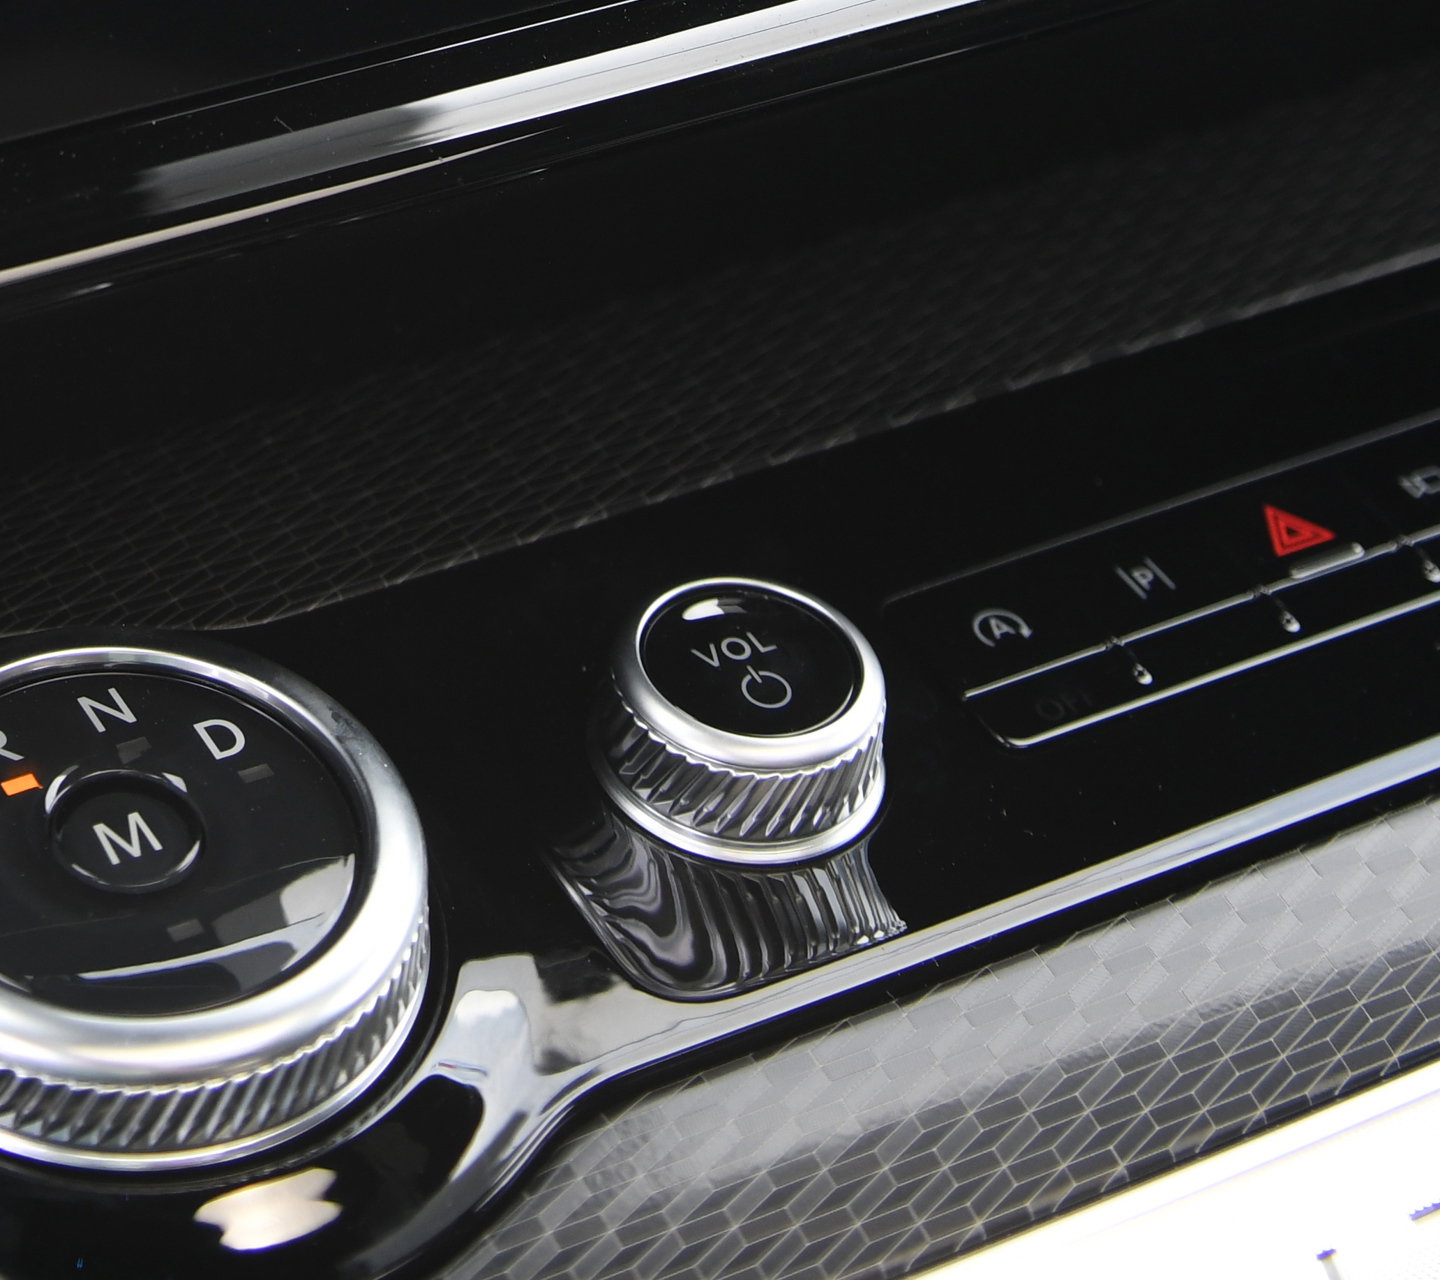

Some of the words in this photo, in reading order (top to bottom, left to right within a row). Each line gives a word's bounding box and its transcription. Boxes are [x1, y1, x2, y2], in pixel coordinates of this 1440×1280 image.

[691, 631, 778, 668] VOL
[77, 688, 137, 732] N
[193, 719, 245, 760] D
[93, 812, 162, 865] M
